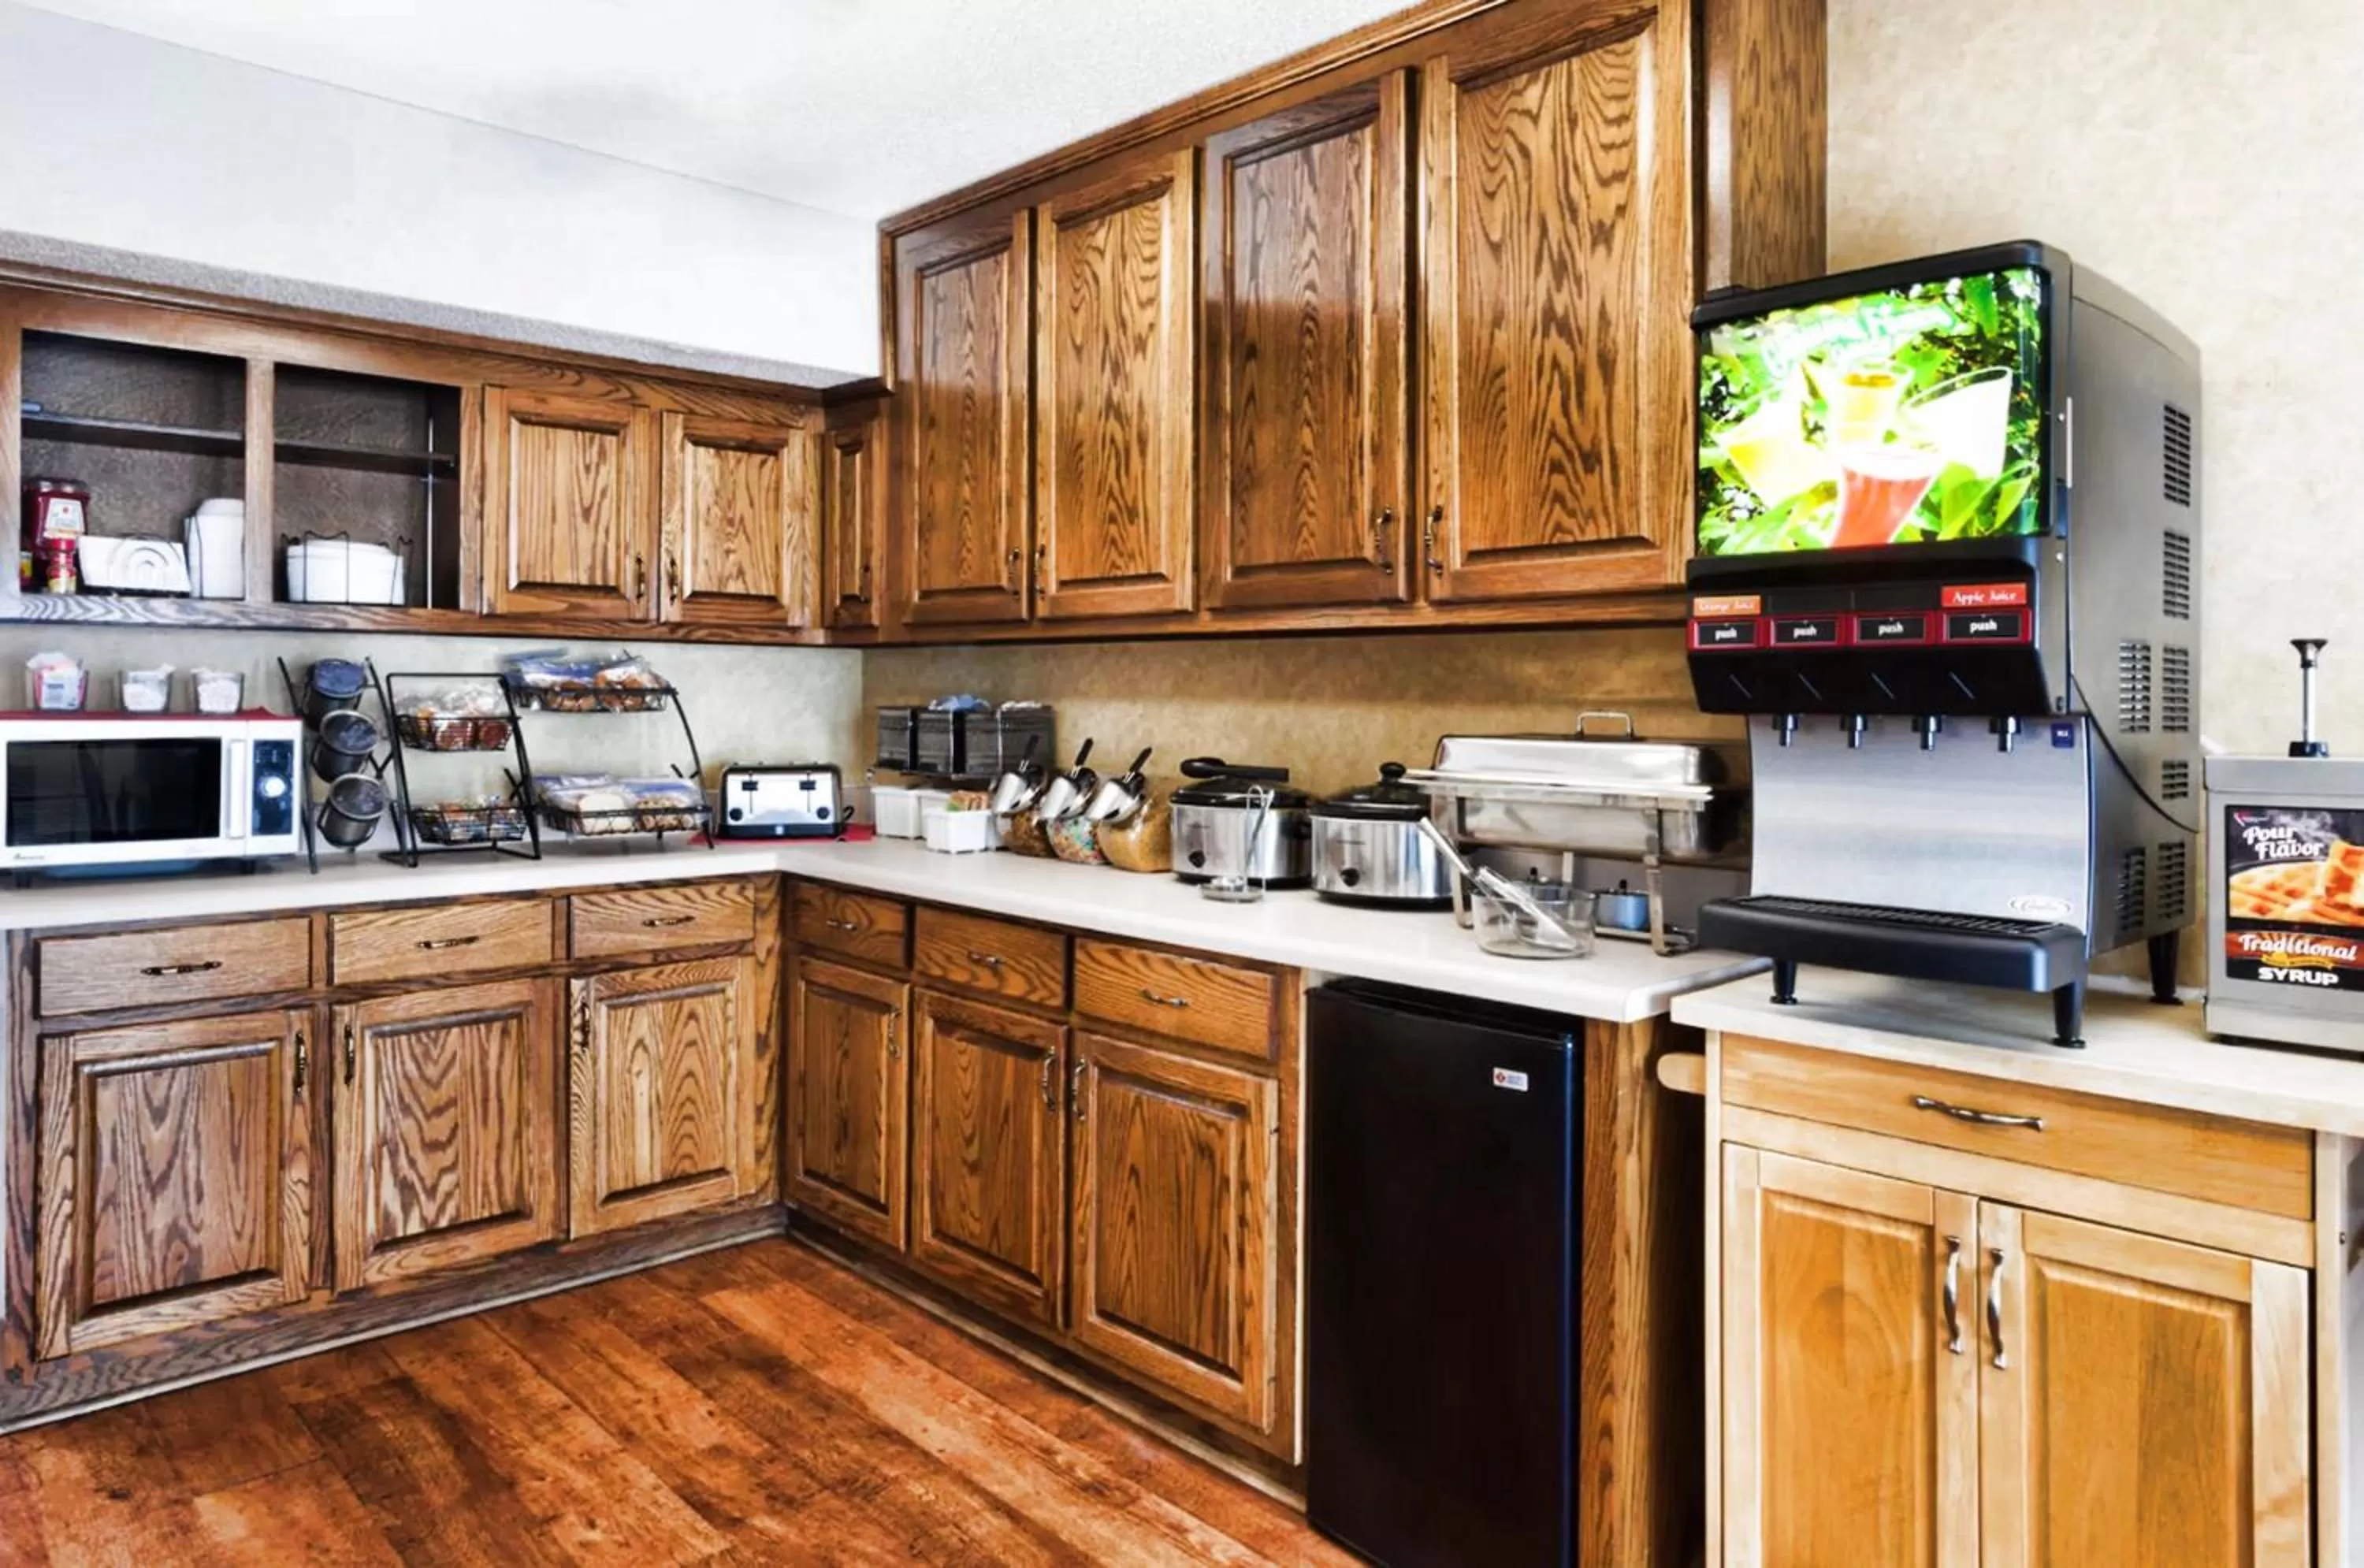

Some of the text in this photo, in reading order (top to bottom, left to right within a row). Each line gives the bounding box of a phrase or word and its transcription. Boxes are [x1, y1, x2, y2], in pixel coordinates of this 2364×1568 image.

[1715, 627, 1738, 641] push
[1793, 625, 1817, 639] push
[1878, 621, 1904, 636] push
[1969, 619, 1998, 634] push
[2242, 825, 2299, 845] Pour
[2254, 838, 2325, 860] Flavor
[2238, 933, 2358, 960] Traditional
[2258, 966, 2340, 985] SYRUP
